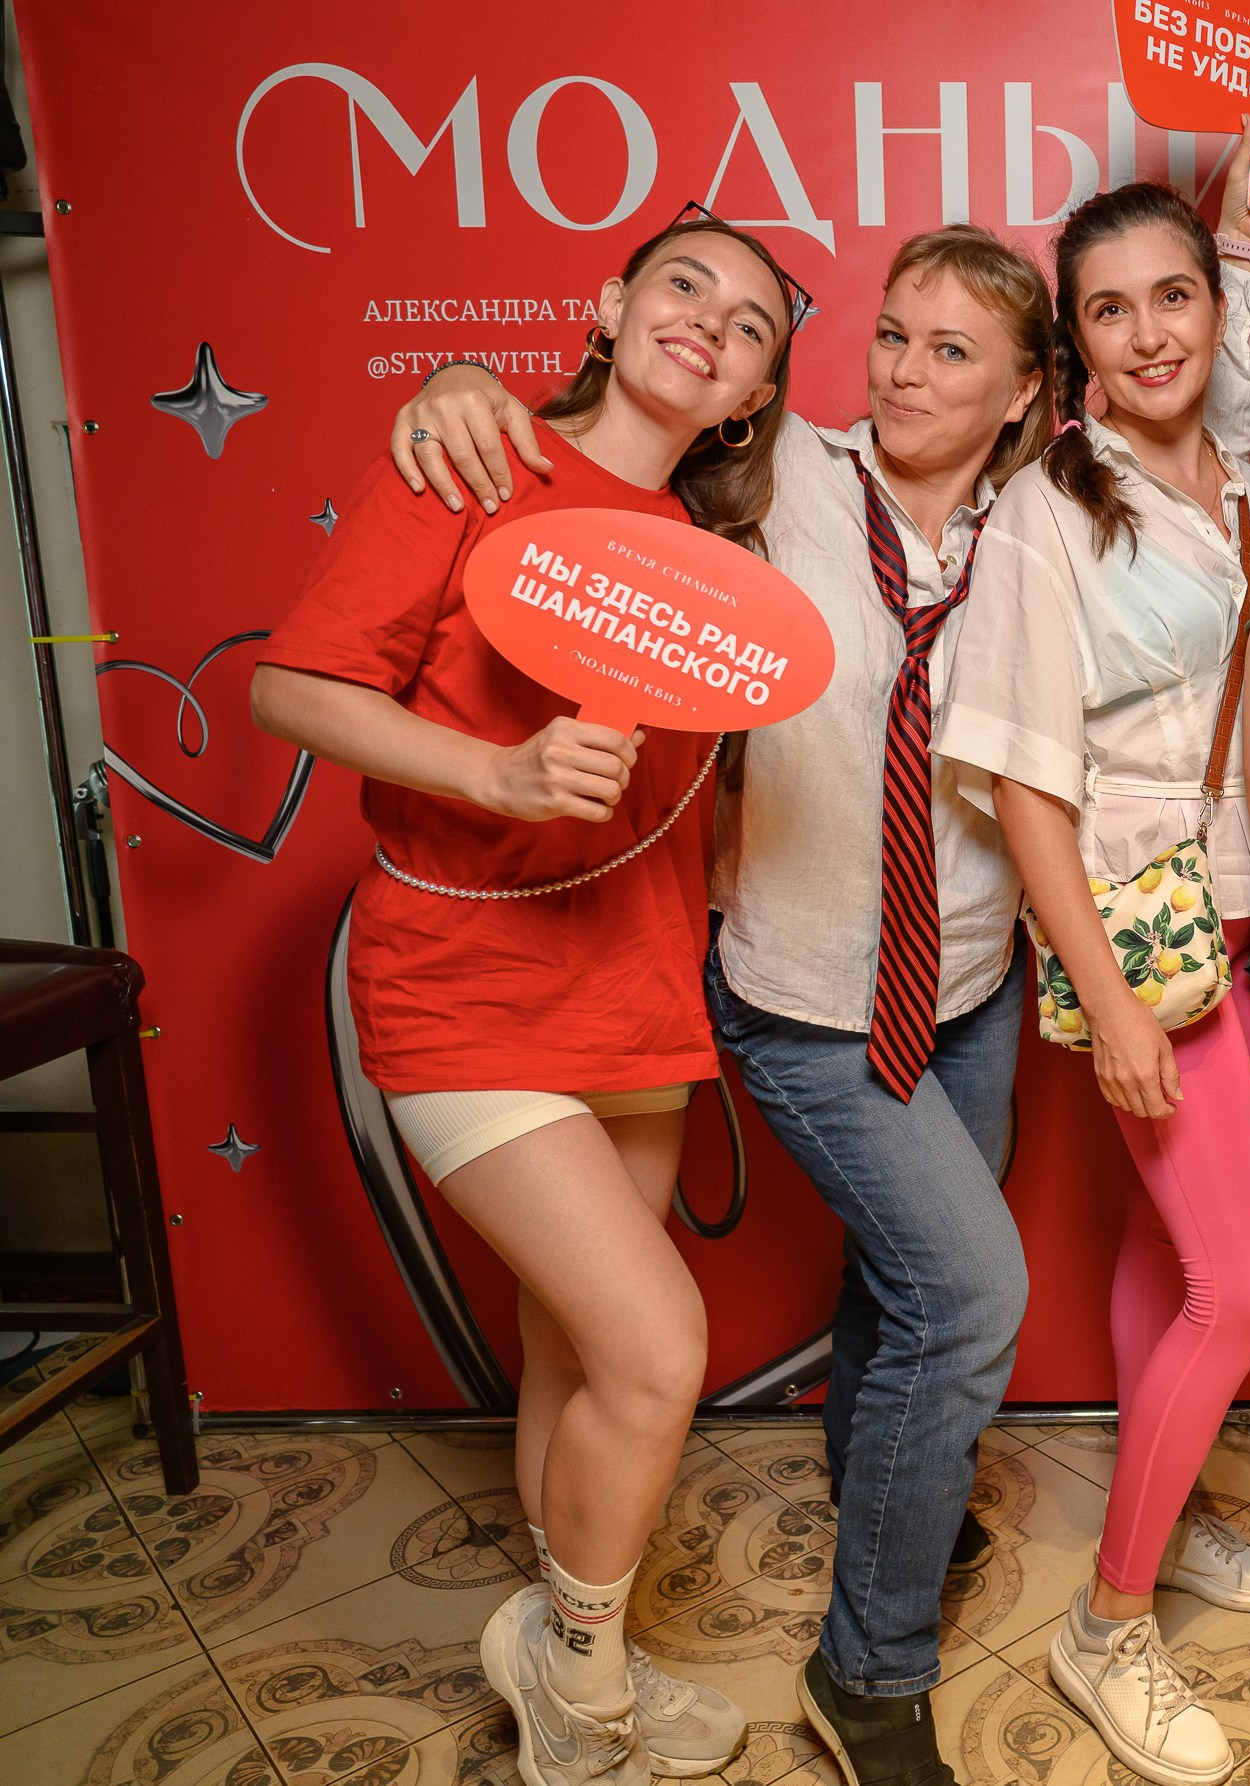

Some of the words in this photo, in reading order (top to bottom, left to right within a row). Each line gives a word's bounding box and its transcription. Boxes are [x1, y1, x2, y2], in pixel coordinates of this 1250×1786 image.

[1134, 0, 1188, 37] БЕЗ
[1146, 35, 1184, 71] НЕ
[363, 299, 557, 326] АЛЕКСАНДРА
[607, 540, 657, 571] ВРЕМЯ
[662, 565, 739, 608] СТИЛЬНЫХ
[520, 542, 583, 588] МЫ
[584, 571, 692, 637] ЗДЕСЬ
[696, 622, 789, 681] РАДИ
[510, 574, 770, 706] ШАМПАНСКОГО
[569, 649, 640, 689] МОДНЫЙ
[644, 682, 683, 707] КВИЗ
[551, 1605, 596, 1657] 32
